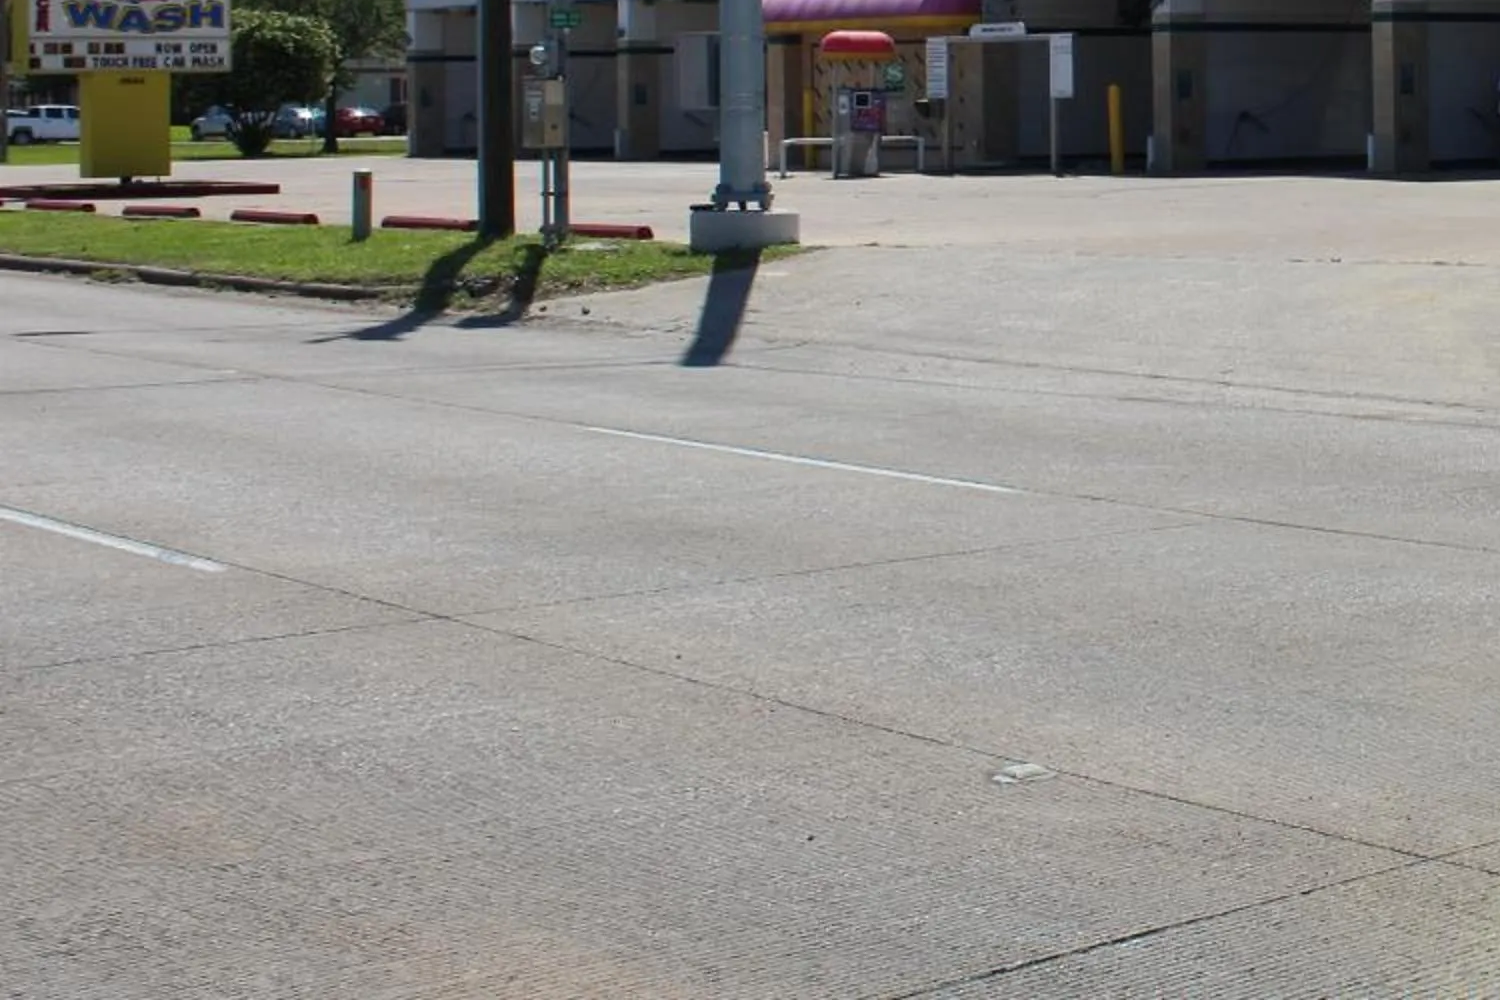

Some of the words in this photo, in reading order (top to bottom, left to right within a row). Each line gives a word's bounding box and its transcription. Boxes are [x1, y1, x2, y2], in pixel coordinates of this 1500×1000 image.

[62, 0, 225, 34] WASH
[155, 42, 182, 54] NOW
[189, 42, 218, 54] OPEN
[92, 56, 129, 69] TOUCH
[132, 56, 157, 69] FREE
[163, 56, 186, 68] CAR
[191, 56, 225, 68] WASH
